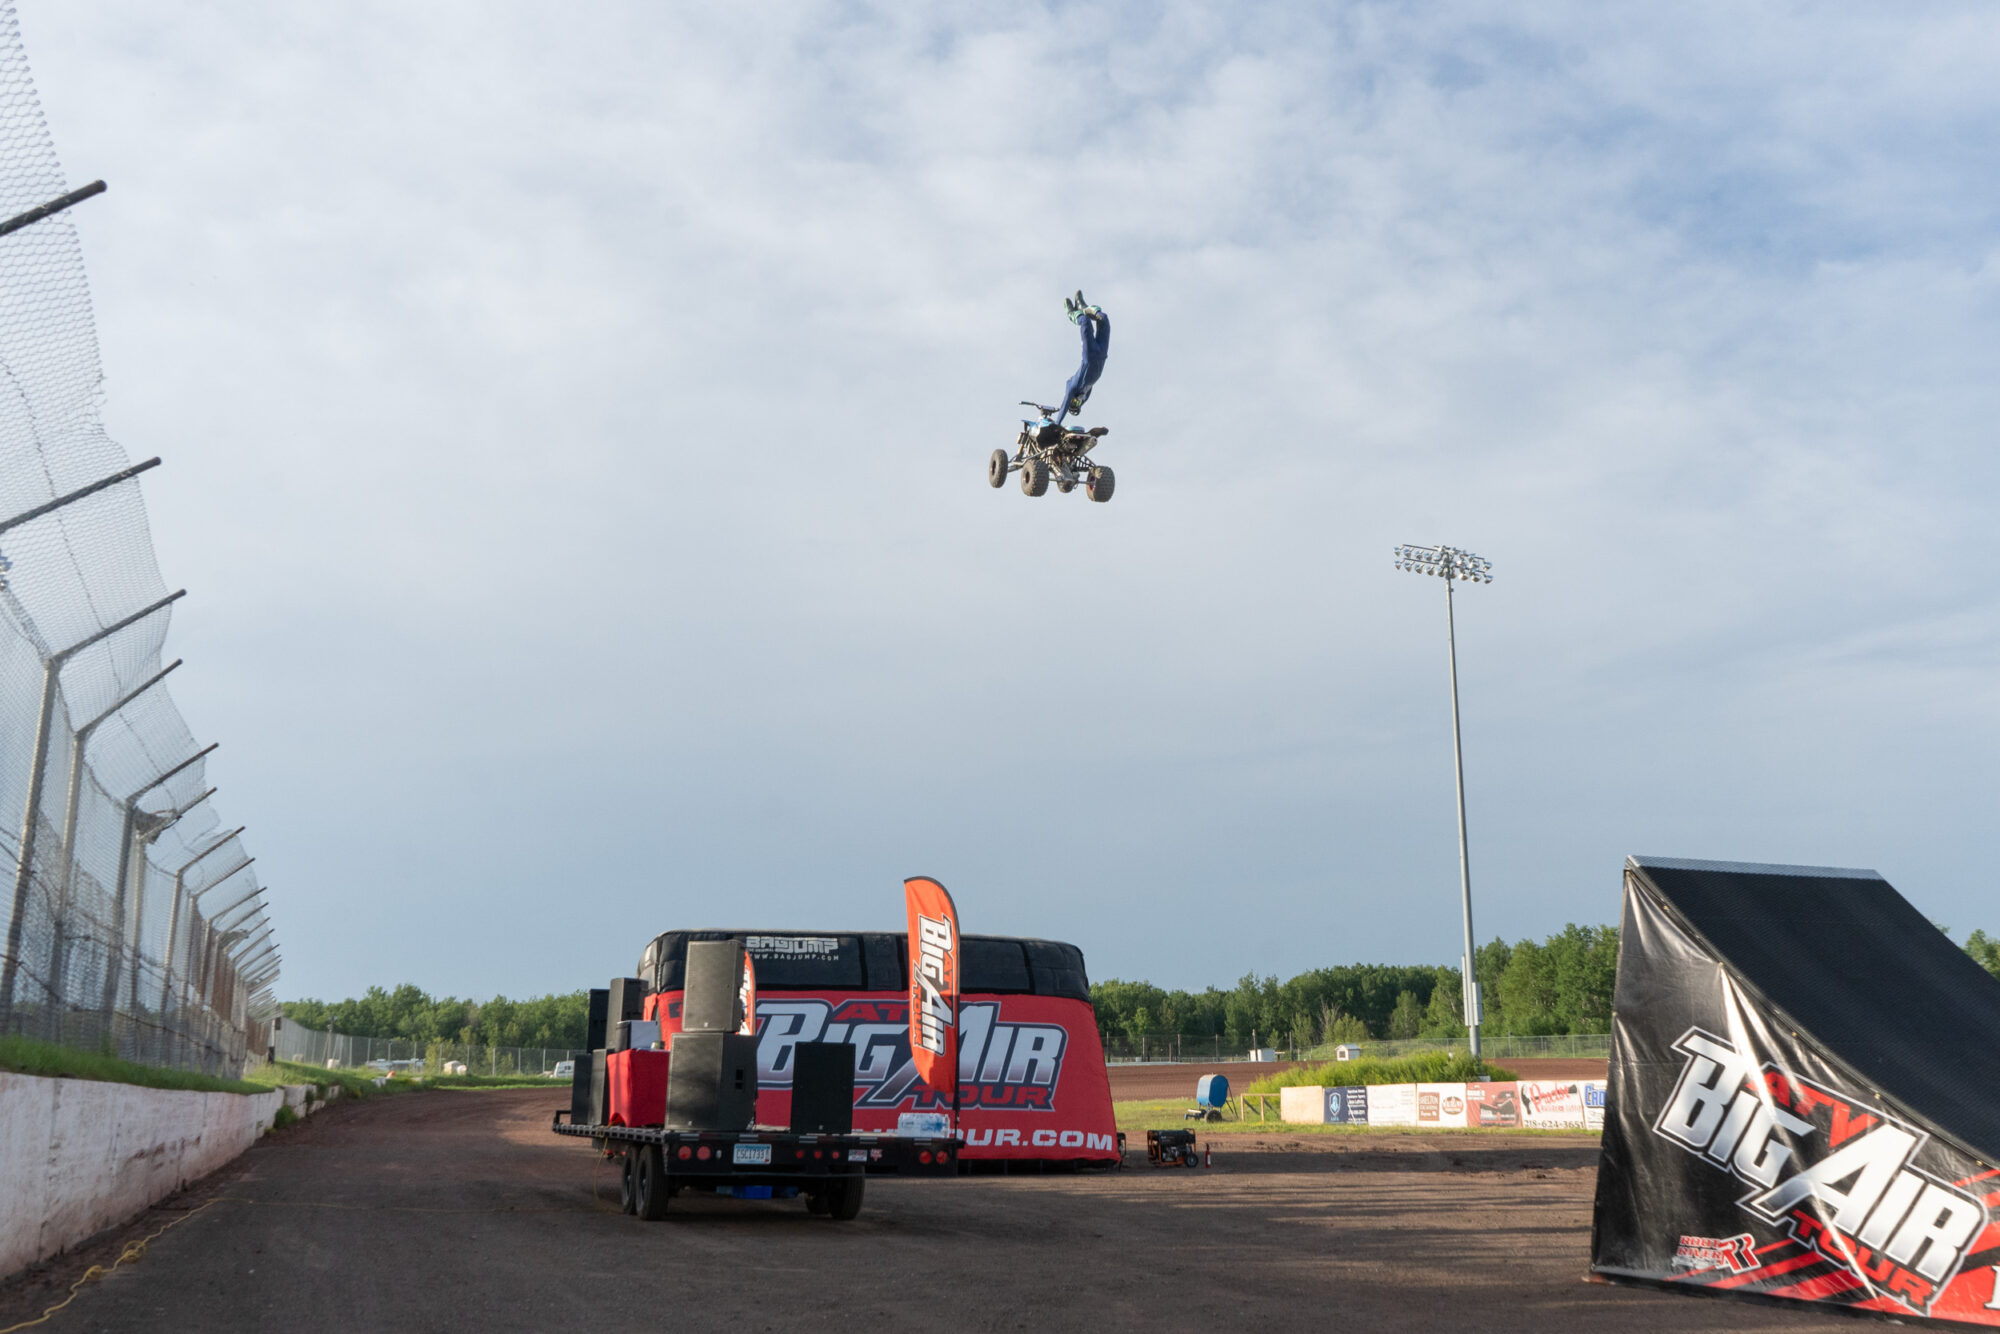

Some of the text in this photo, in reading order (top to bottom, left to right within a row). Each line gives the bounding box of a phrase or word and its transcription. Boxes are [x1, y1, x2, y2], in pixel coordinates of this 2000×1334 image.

[746, 936, 838, 953] BAGJUMP
[834, 1002, 909, 1022] AT
[912, 985, 922, 1045] TOUR
[914, 914, 953, 1056] BIG AIR
[912, 1085, 1051, 1106] TOUR
[1746, 1070, 1879, 1148] ATV
[1660, 1034, 1983, 1282] BIG AIR
[1792, 1209, 1934, 1307] TOUR
